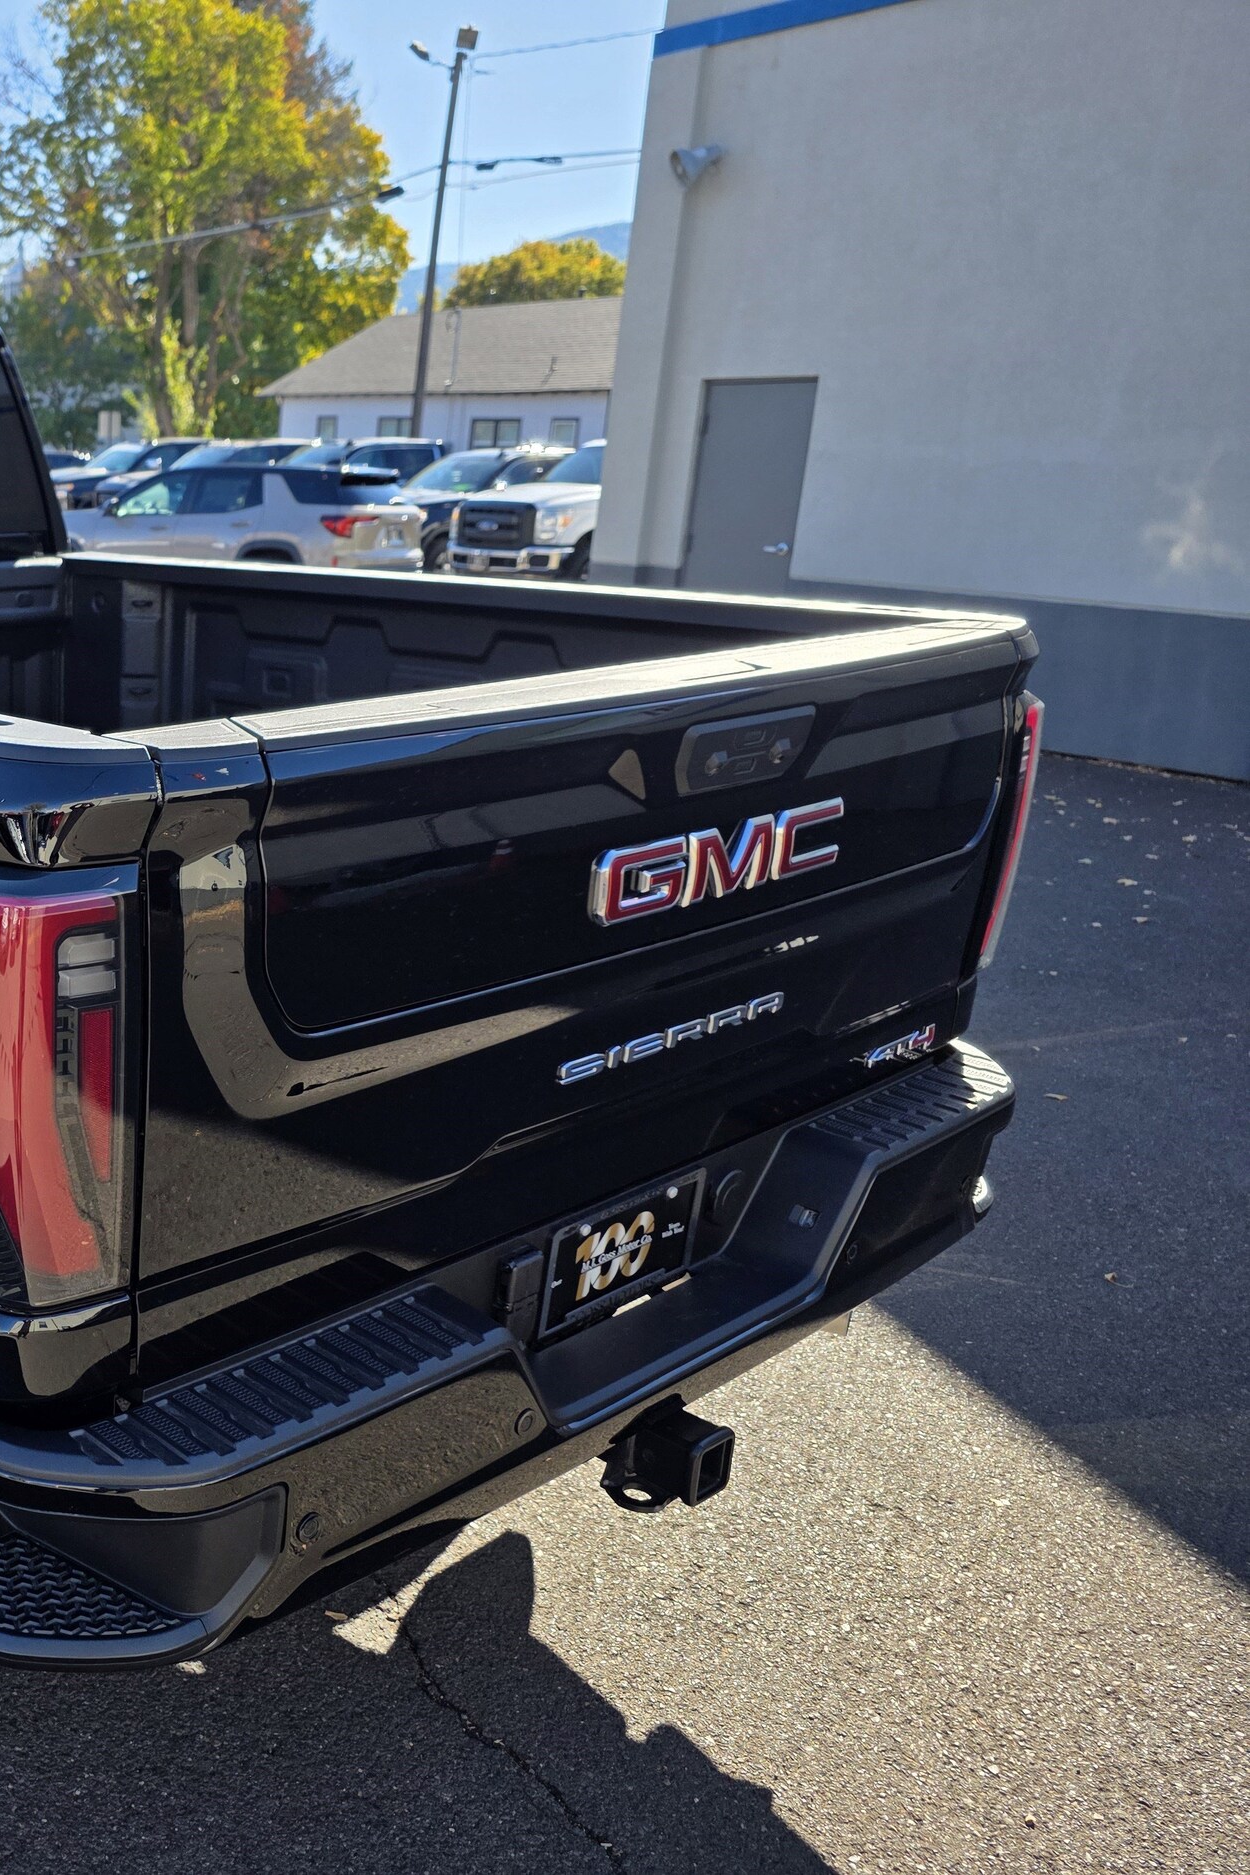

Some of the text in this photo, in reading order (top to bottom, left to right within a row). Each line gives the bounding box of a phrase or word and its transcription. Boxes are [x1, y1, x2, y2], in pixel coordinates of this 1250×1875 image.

[588, 797, 844, 927] GMC
[556, 991, 785, 1085] SIERRA
[575, 1211, 655, 1302] 100
